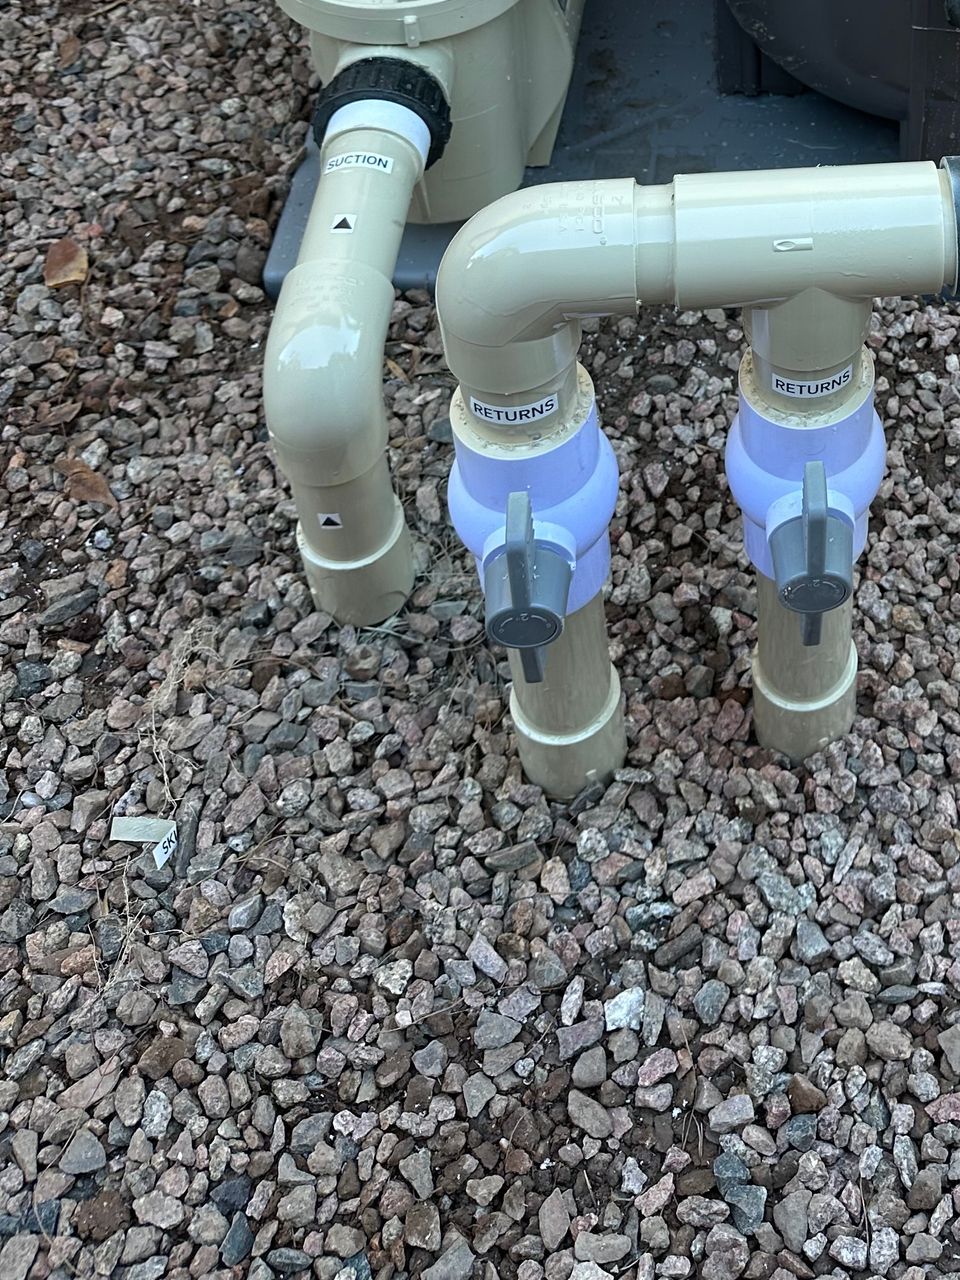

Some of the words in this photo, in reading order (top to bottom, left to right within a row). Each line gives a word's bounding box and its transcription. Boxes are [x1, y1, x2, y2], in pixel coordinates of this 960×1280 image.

[327, 154, 389, 170] SUCTION
[775, 370, 850, 395] RETURNS
[473, 398, 554, 421] RETURNS
